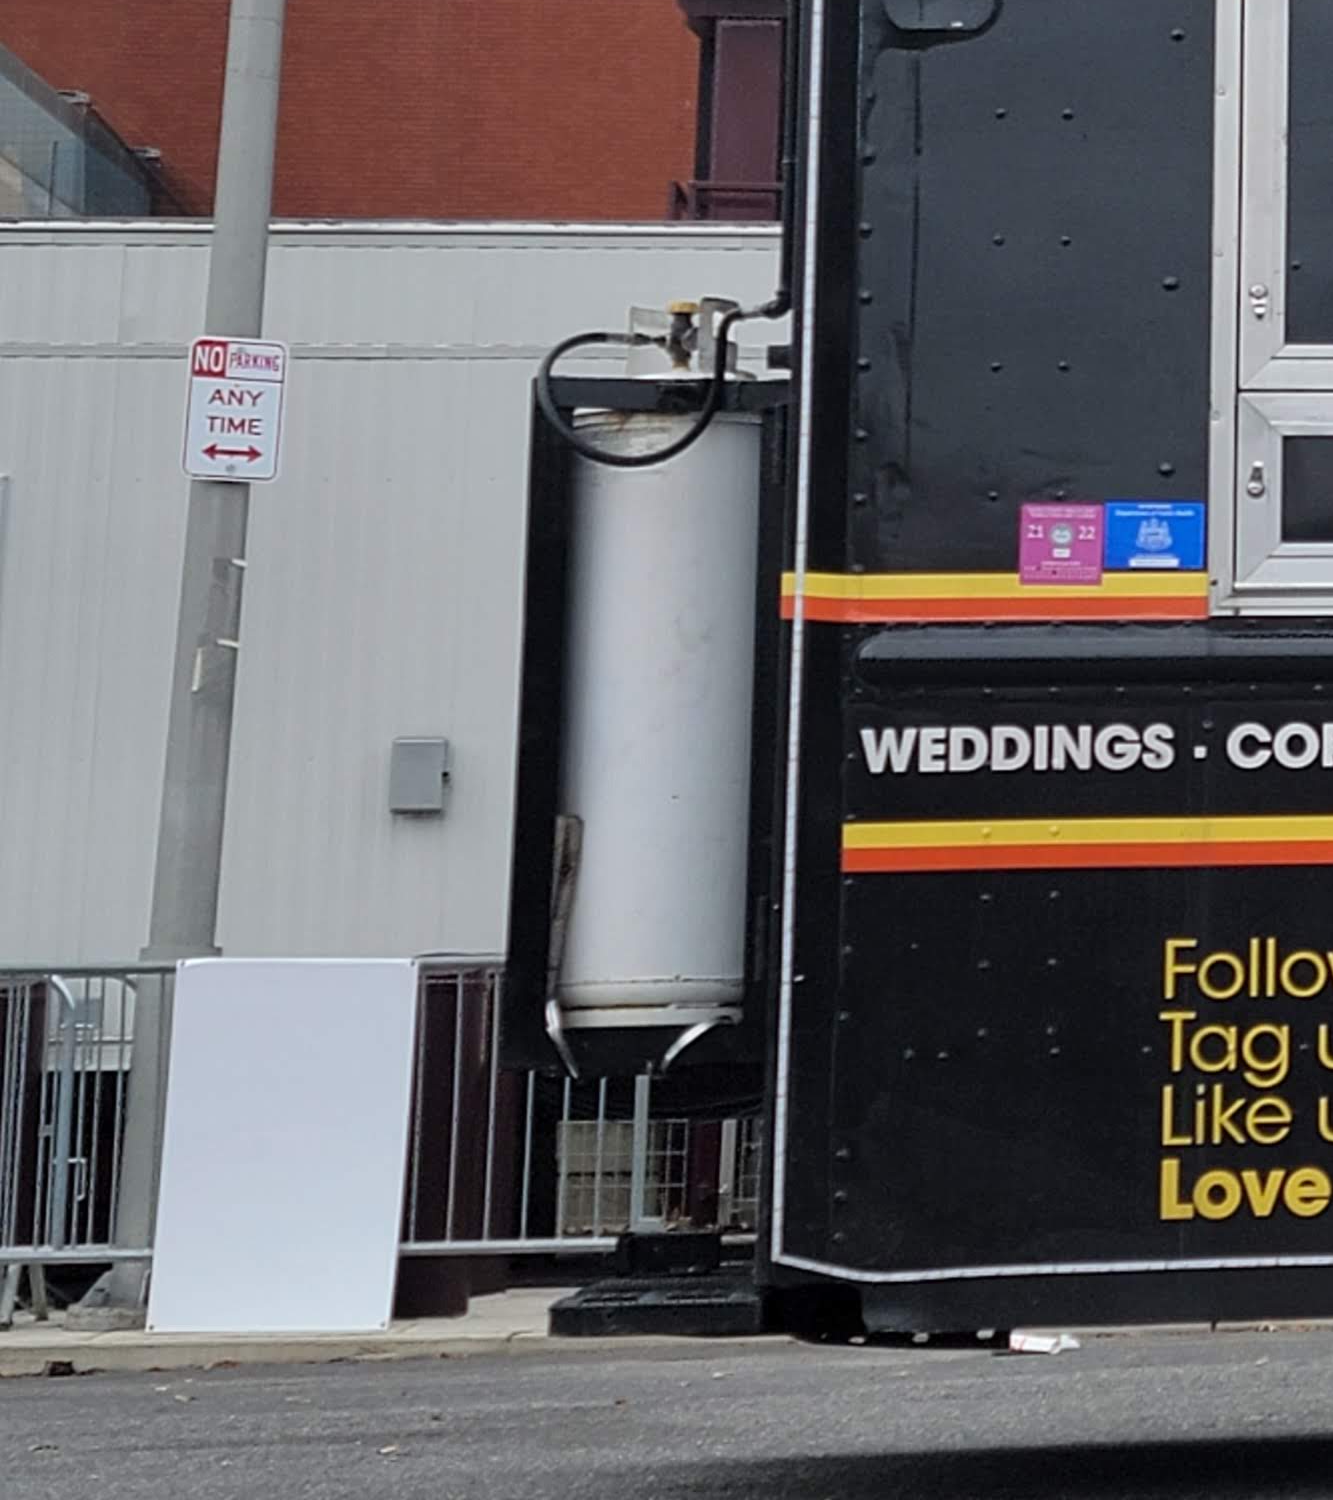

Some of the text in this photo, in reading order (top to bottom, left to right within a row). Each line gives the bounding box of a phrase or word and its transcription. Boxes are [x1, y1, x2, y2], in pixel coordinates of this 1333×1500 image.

[194, 343, 281, 373] NO PARKING
[208, 388, 264, 407] ANY
[207, 414, 264, 436] TIME
[1026, 524, 1096, 540] 21 22
[860, 723, 1174, 773] WEDDINGS
[1160, 1011, 1290, 1088] Tag
[1162, 1084, 1292, 1146] Like
[1160, 1157, 1332, 1220] Love
